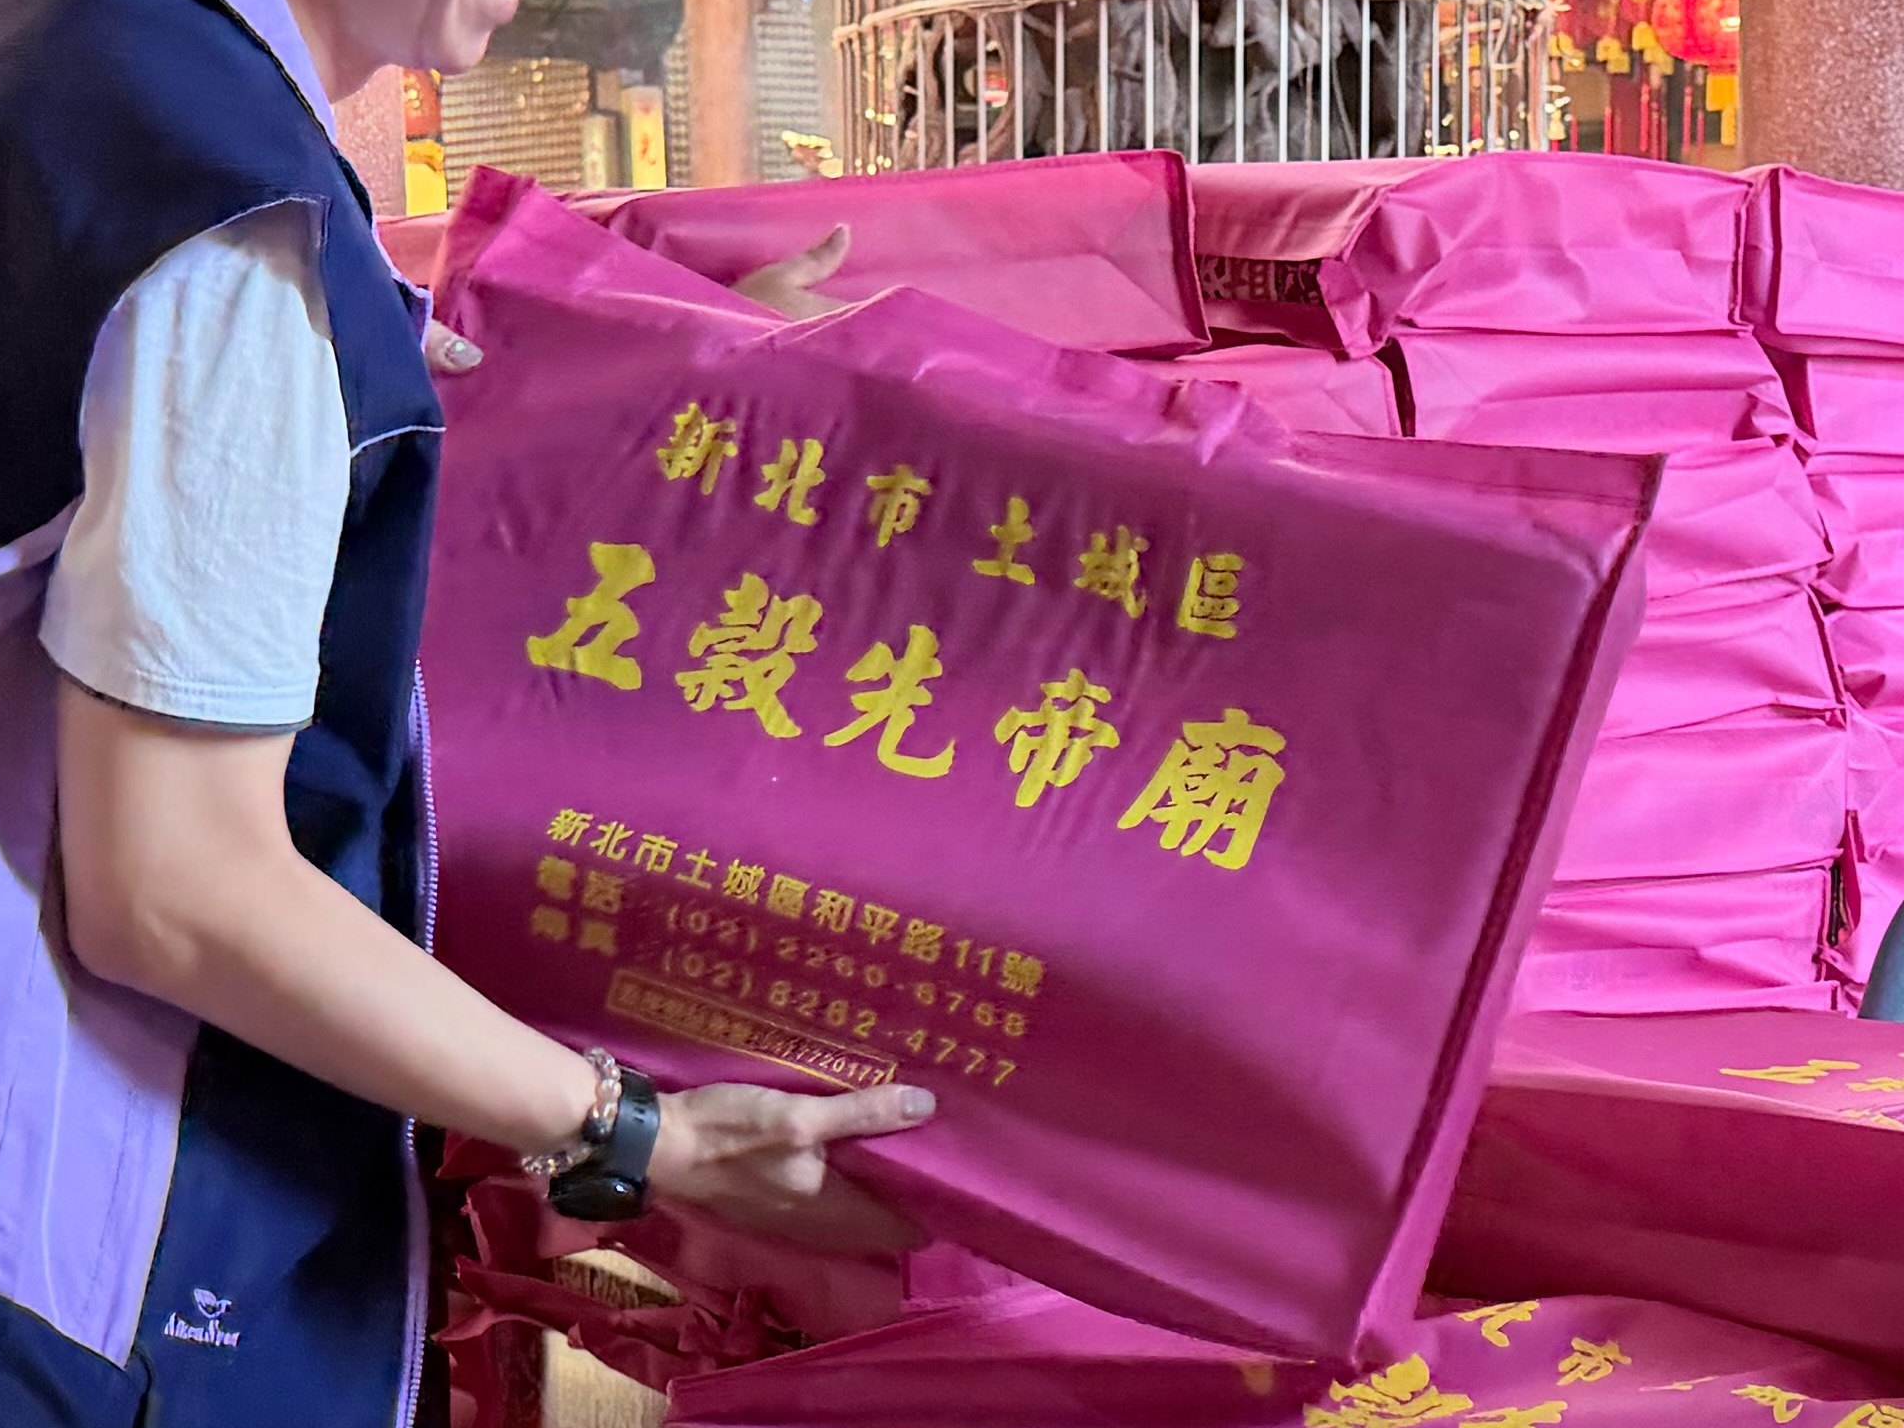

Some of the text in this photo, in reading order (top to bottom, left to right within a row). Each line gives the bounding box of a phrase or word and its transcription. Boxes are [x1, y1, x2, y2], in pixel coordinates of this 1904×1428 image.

[656, 402, 1245, 640] 新北市土城區
[527, 541, 1287, 871] 五穀先帝廟
[546, 807, 1045, 998] 新北市土城區和平路11號
[663, 944, 755, 998] (02)
[667, 901, 758, 954] (02)
